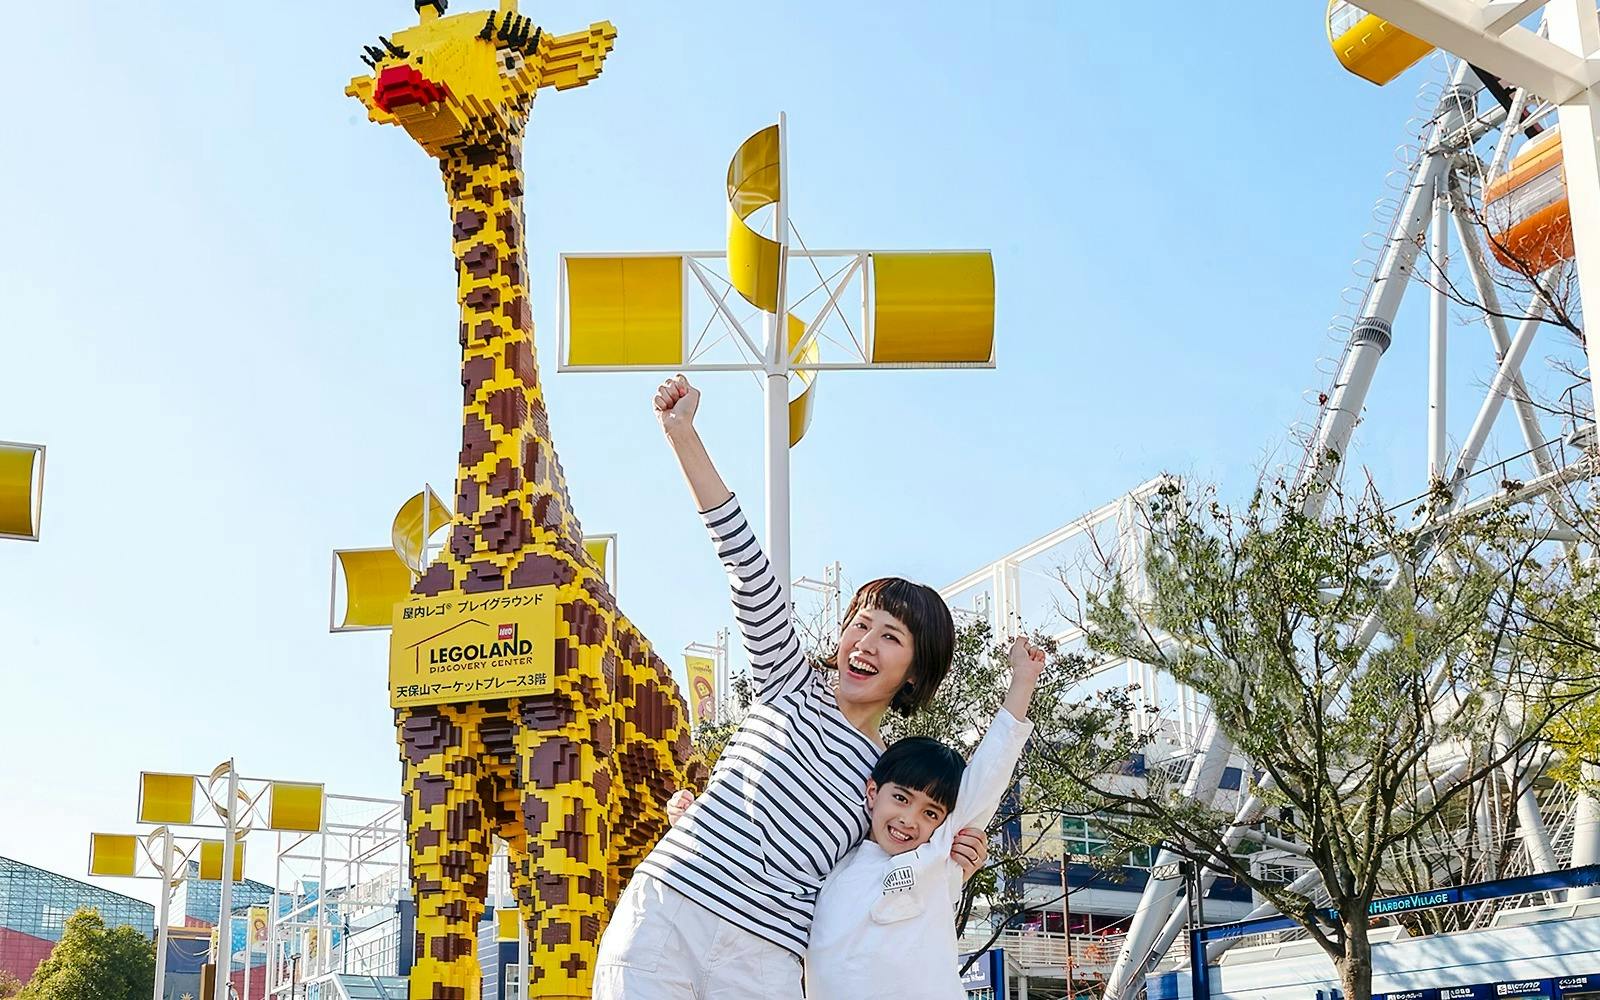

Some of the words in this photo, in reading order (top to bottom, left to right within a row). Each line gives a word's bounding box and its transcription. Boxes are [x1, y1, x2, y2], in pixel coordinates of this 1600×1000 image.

[458, 593, 544, 614] プレイグラウンド
[430, 623, 533, 664] LEGOLAND
[430, 661, 487, 674] DISCOVERY
[491, 656, 533, 668] CENTER
[396, 673, 547, 698] 天保山マーケットプレース3階
[1410, 894, 1448, 908] VILLAGE
